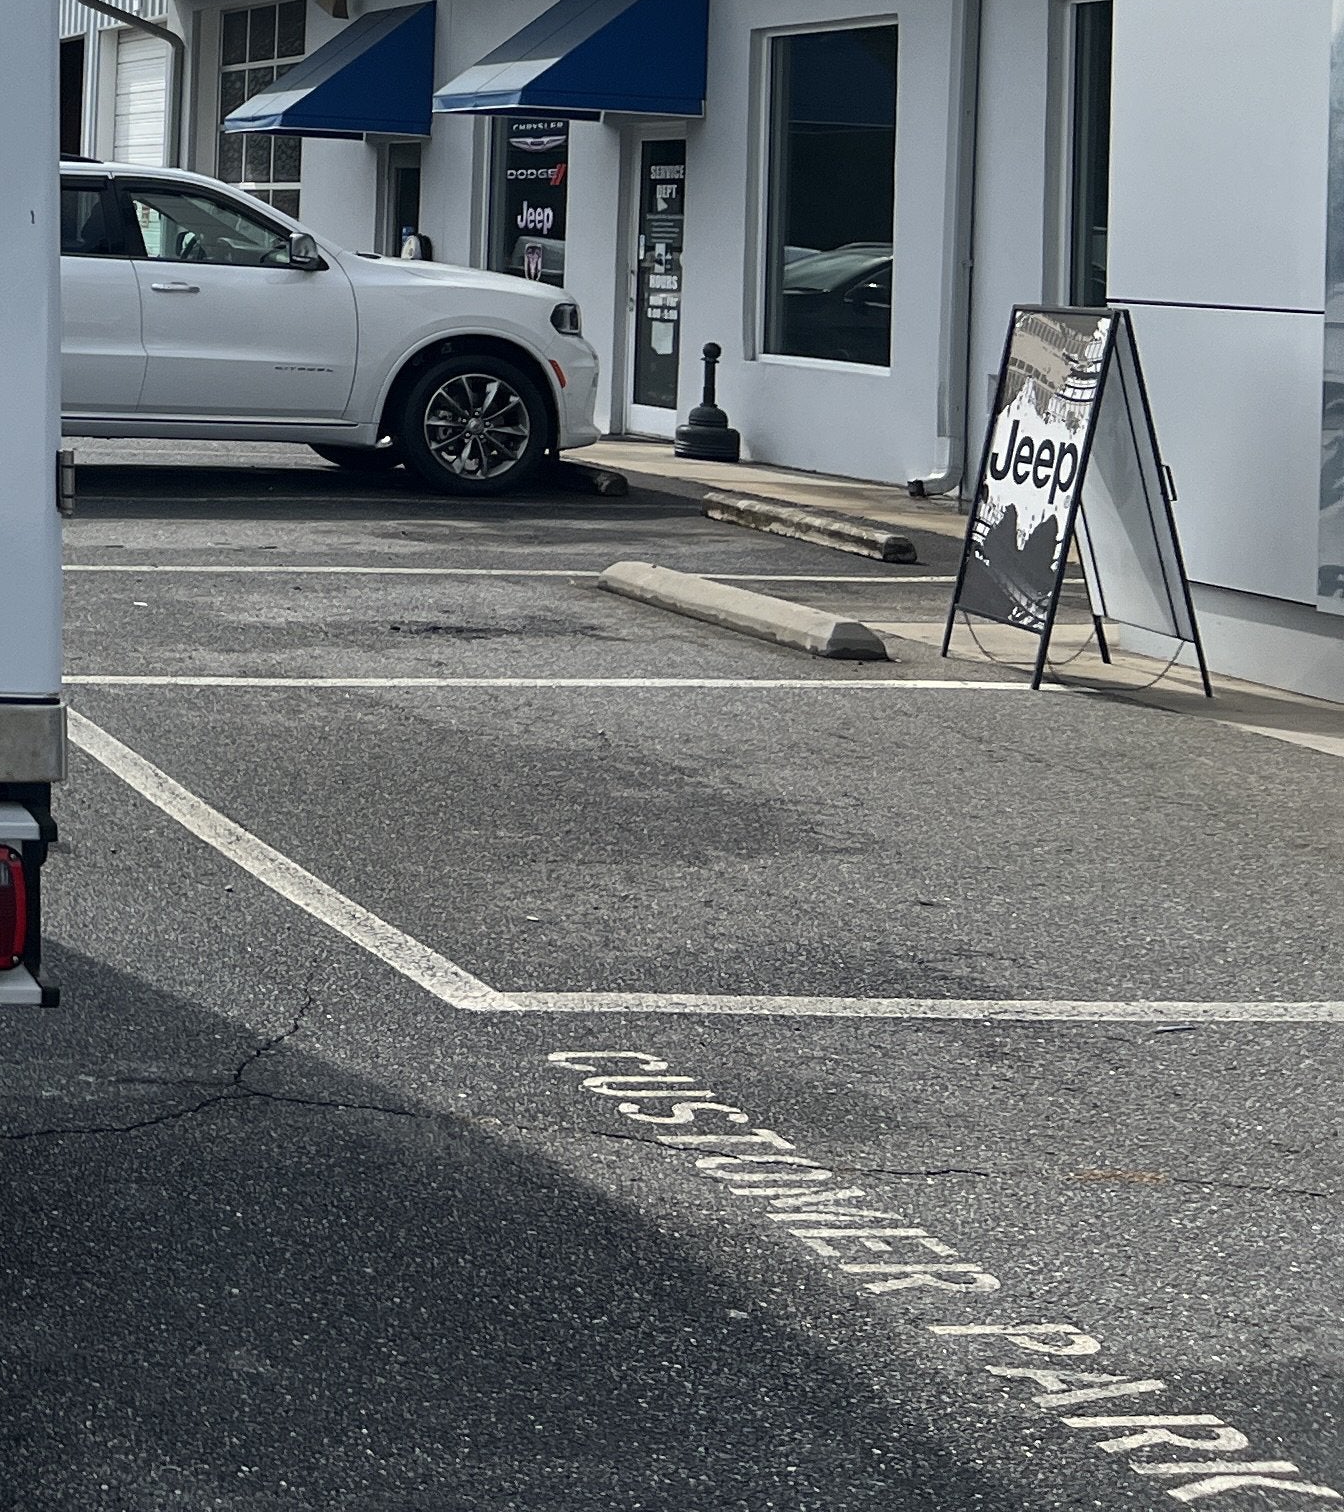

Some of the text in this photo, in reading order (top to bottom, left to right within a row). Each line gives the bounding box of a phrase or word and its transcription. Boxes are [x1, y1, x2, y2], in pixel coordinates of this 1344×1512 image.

[507, 168, 557, 180] DODGE
[650, 165, 685, 180] SERVICE
[656, 184, 678, 199] DEPT
[517, 201, 554, 235] Jeep
[990, 419, 1078, 505] Jeep
[547, 1051, 1001, 1294] CUSTOMER
[927, 1323, 1344, 1502] PARK
